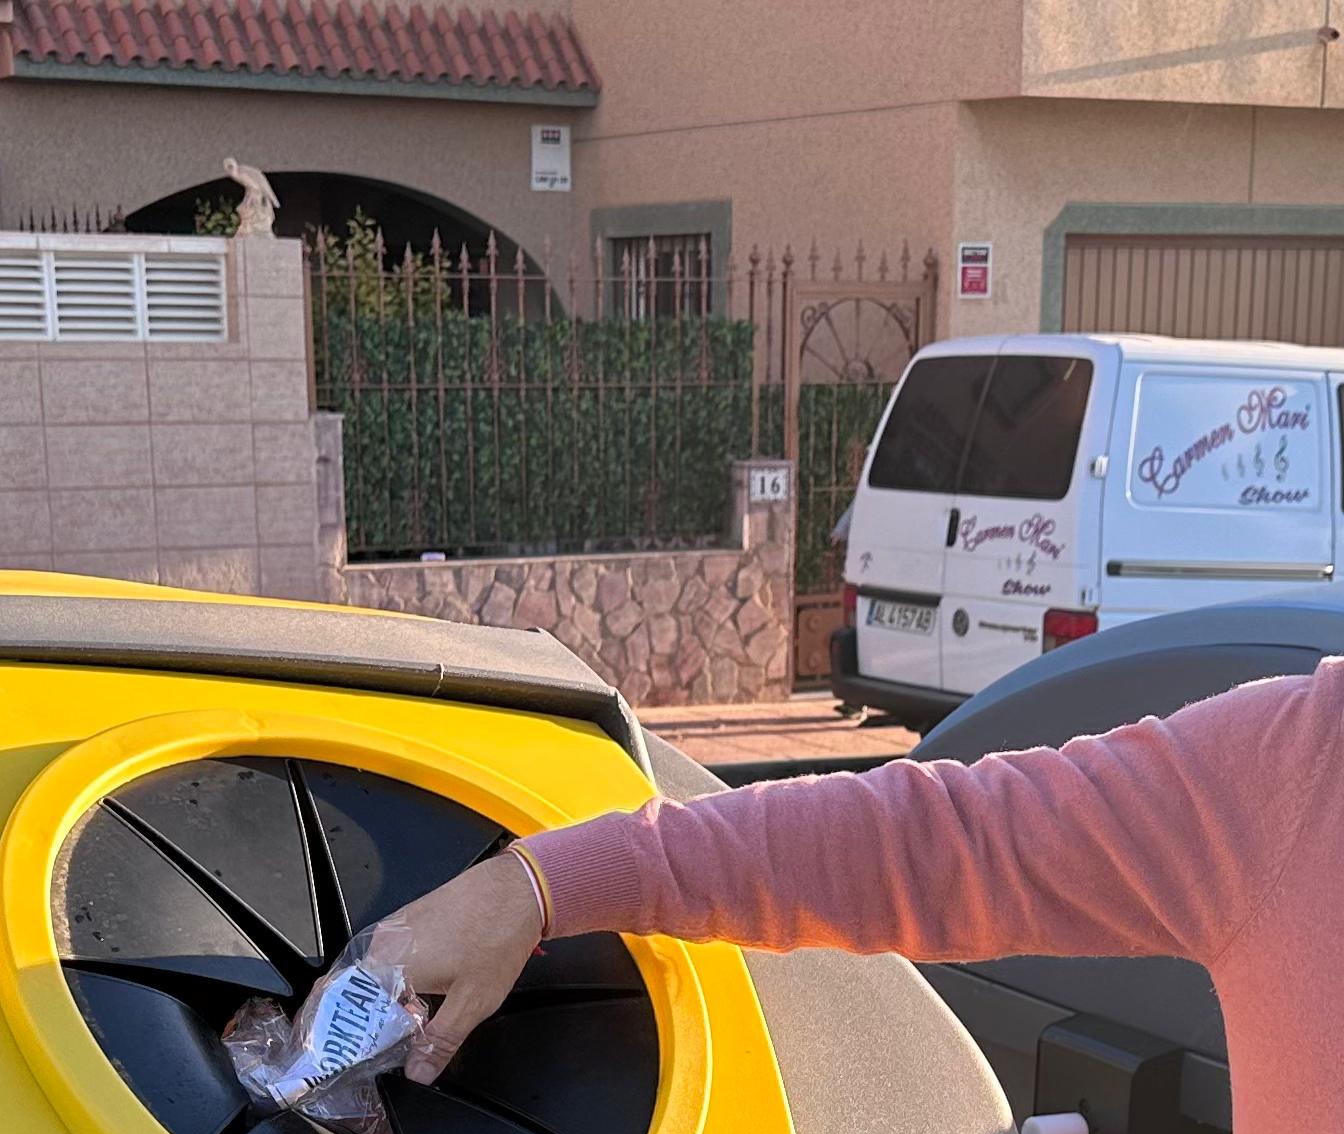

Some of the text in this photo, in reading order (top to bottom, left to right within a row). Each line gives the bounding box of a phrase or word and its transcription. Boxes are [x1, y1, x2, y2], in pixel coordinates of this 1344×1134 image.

[1138, 386, 1312, 499] Carmen Mari
[760, 476, 781, 495] 16
[1238, 485, 1312, 505] Show
[960, 516, 1015, 550] Carmen
[1002, 578, 1052, 597] Show
[303, 965, 381, 1089] ORKTEAM
